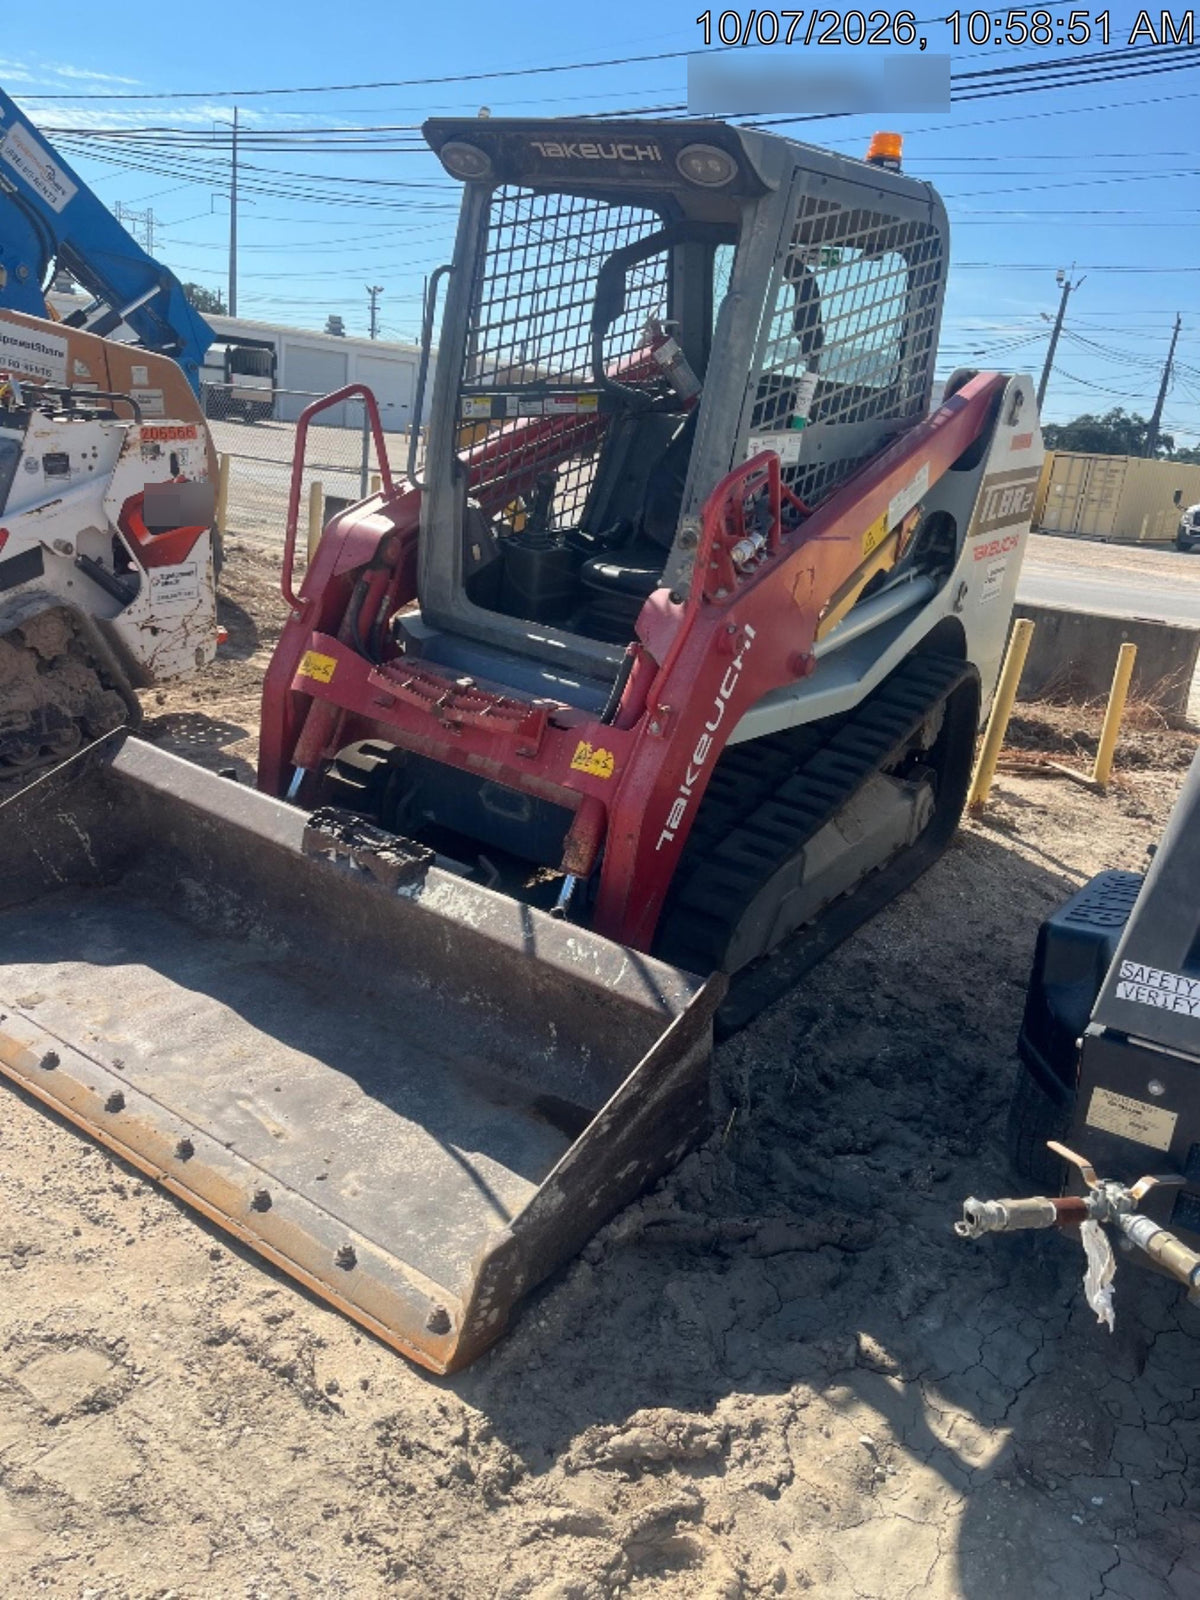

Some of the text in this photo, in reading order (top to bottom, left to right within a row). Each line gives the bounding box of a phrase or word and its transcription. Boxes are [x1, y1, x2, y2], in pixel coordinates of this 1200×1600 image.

[530, 141, 662, 161] TAKEUCHI
[655, 623, 757, 851] TAKEUCHI
[1121, 962, 1198, 998] SAFETY
[1122, 982, 1200, 1015] VERIFY
